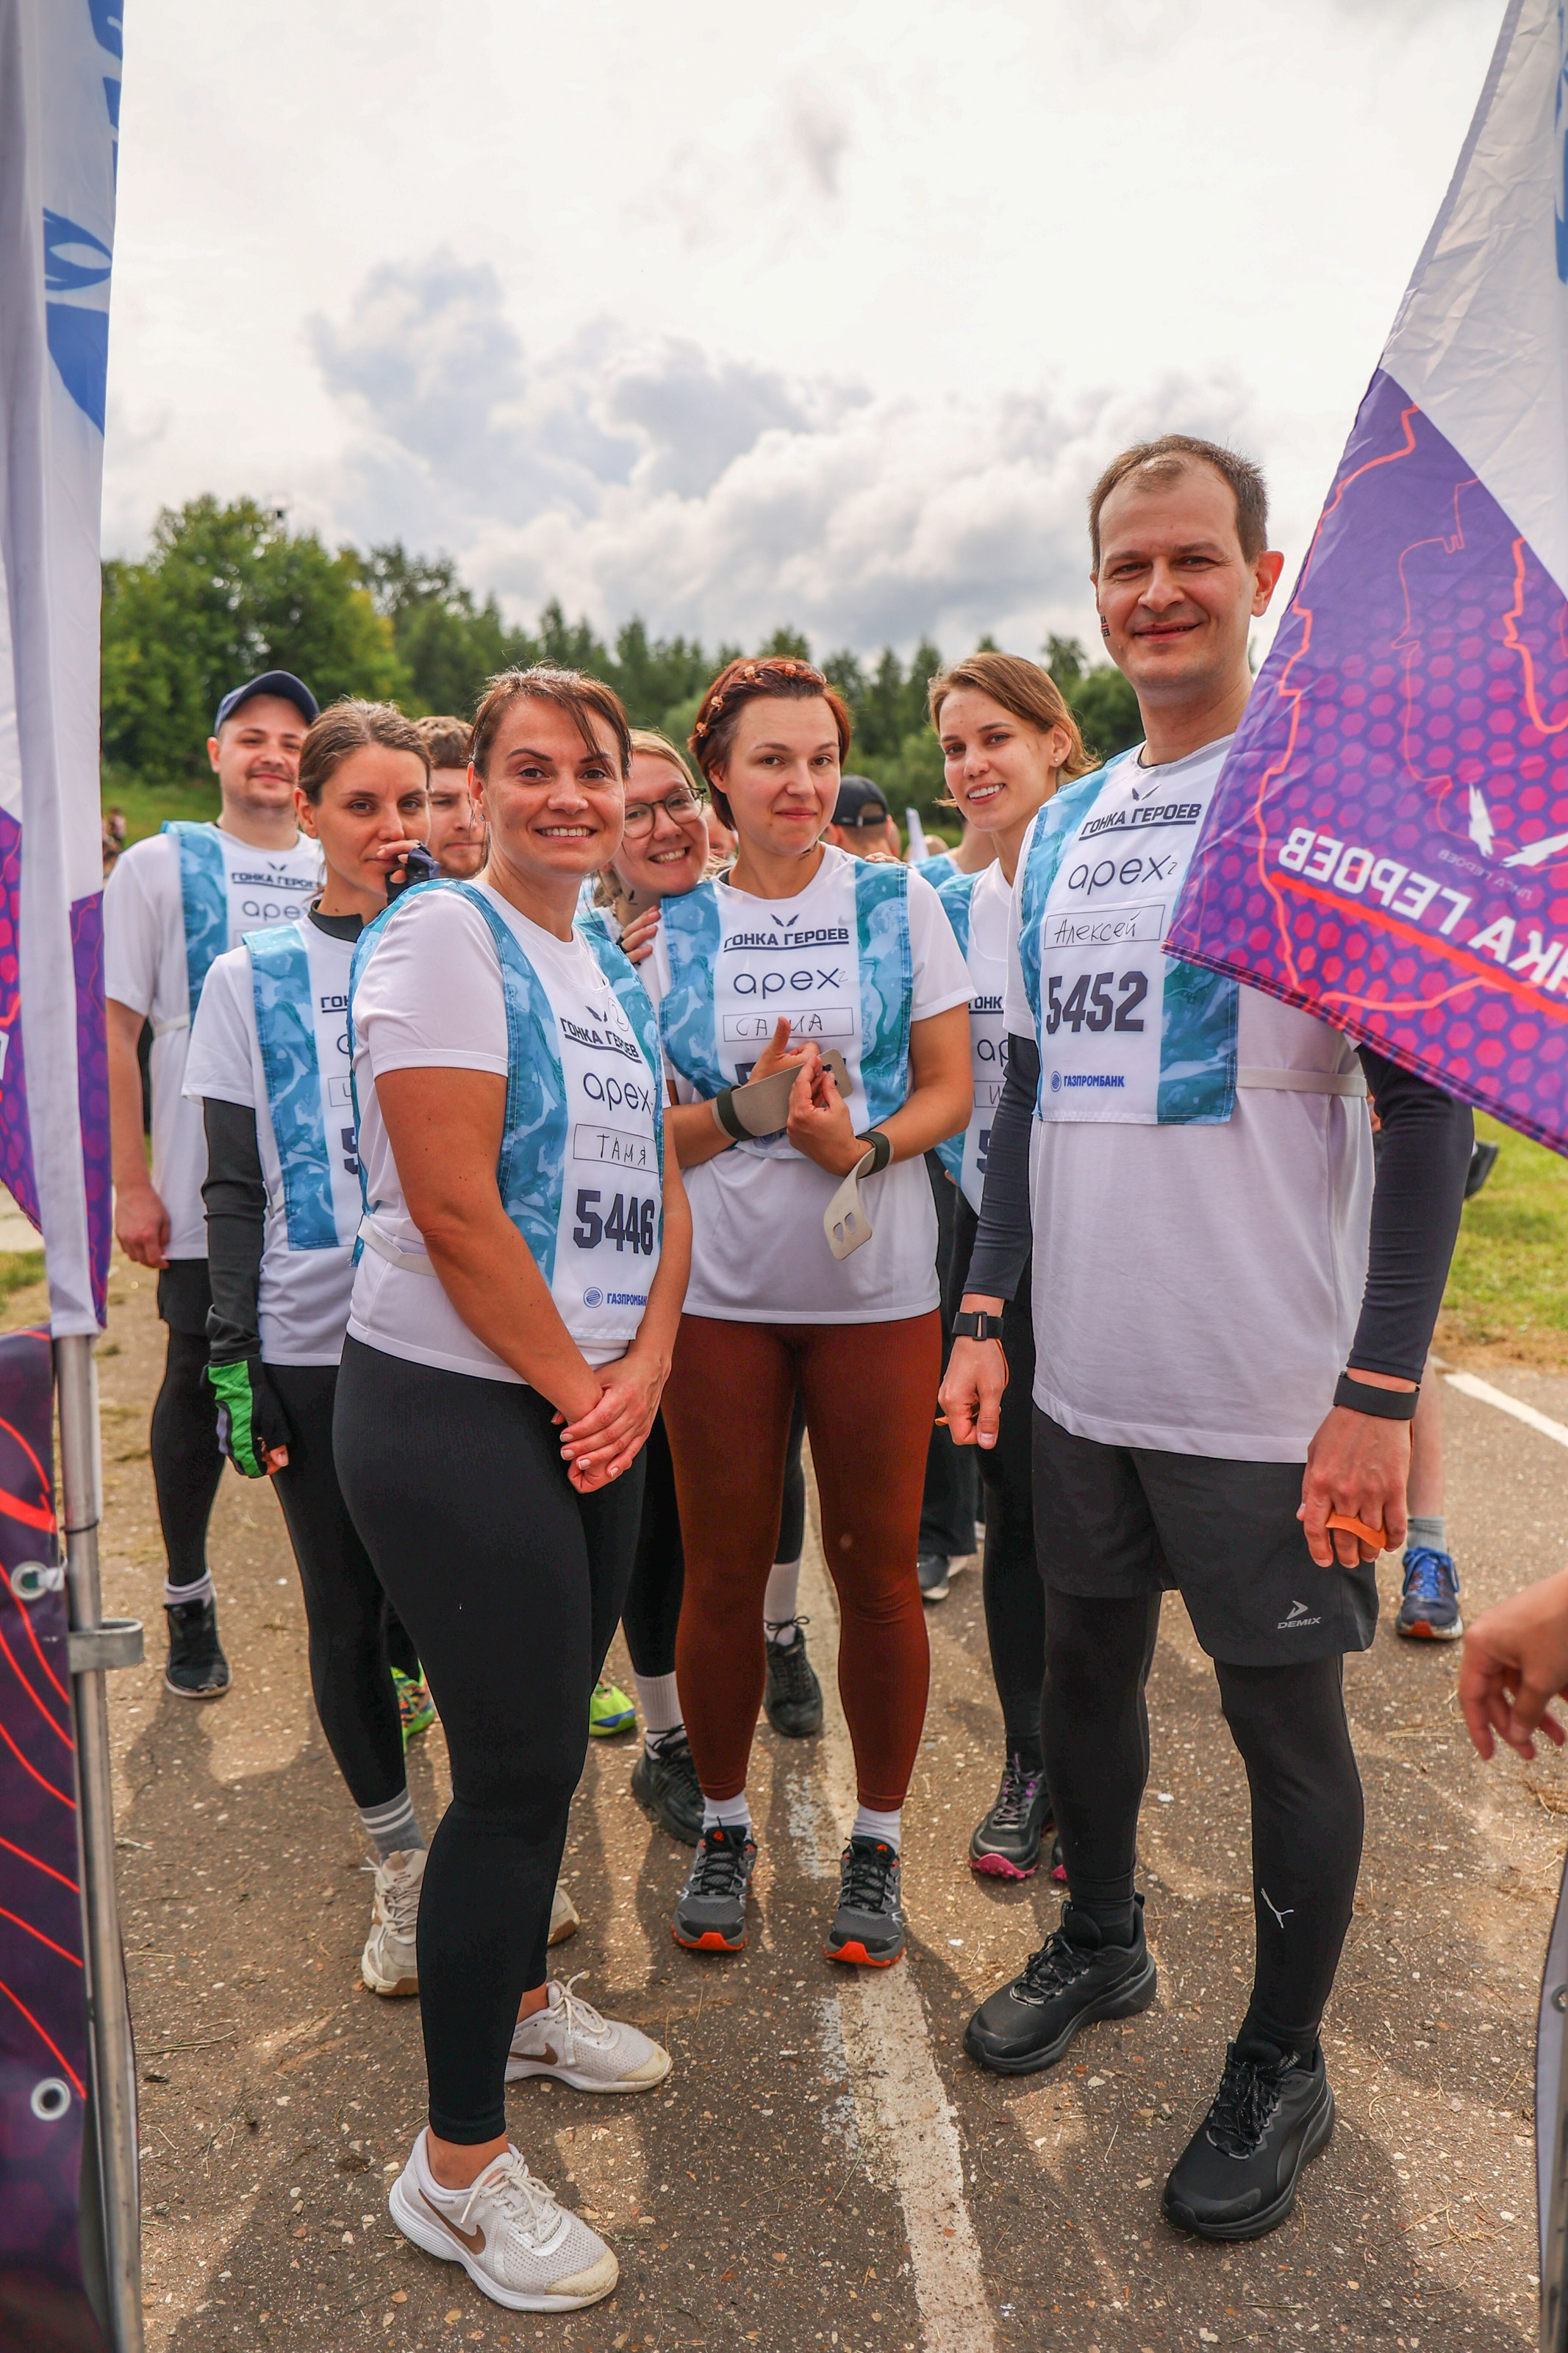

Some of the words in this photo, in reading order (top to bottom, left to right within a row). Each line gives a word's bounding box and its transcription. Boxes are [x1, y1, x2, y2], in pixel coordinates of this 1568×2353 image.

[1081, 810, 1125, 837] ГОНКА
[1131, 803, 1202, 824] ГЕРОЕВ
[232, 873, 273, 882] ГОНКА
[278, 876, 315, 888] ГЕРОЕ
[1068, 854, 1171, 896] apex
[724, 932, 779, 949] ГОНКА
[784, 928, 849, 946] ГЕРОЕВ
[1054, 910, 1141, 945] Алексей
[734, 968, 840, 1000] apex
[1046, 971, 1148, 1035] 5452
[560, 1017, 603, 1045] ГОНКА
[604, 1029, 640, 1058] ГЕРОЕВ
[583, 1072, 651, 1115] apex
[1064, 1074, 1125, 1088] ГАЗПРОМБАНК
[596, 1134, 647, 1165] ТАНЯ
[573, 1189, 654, 1256] 5446
[606, 1293, 648, 1306] ГАЗПРОМБАН
[1277, 1616, 1322, 1629] DEMIX
